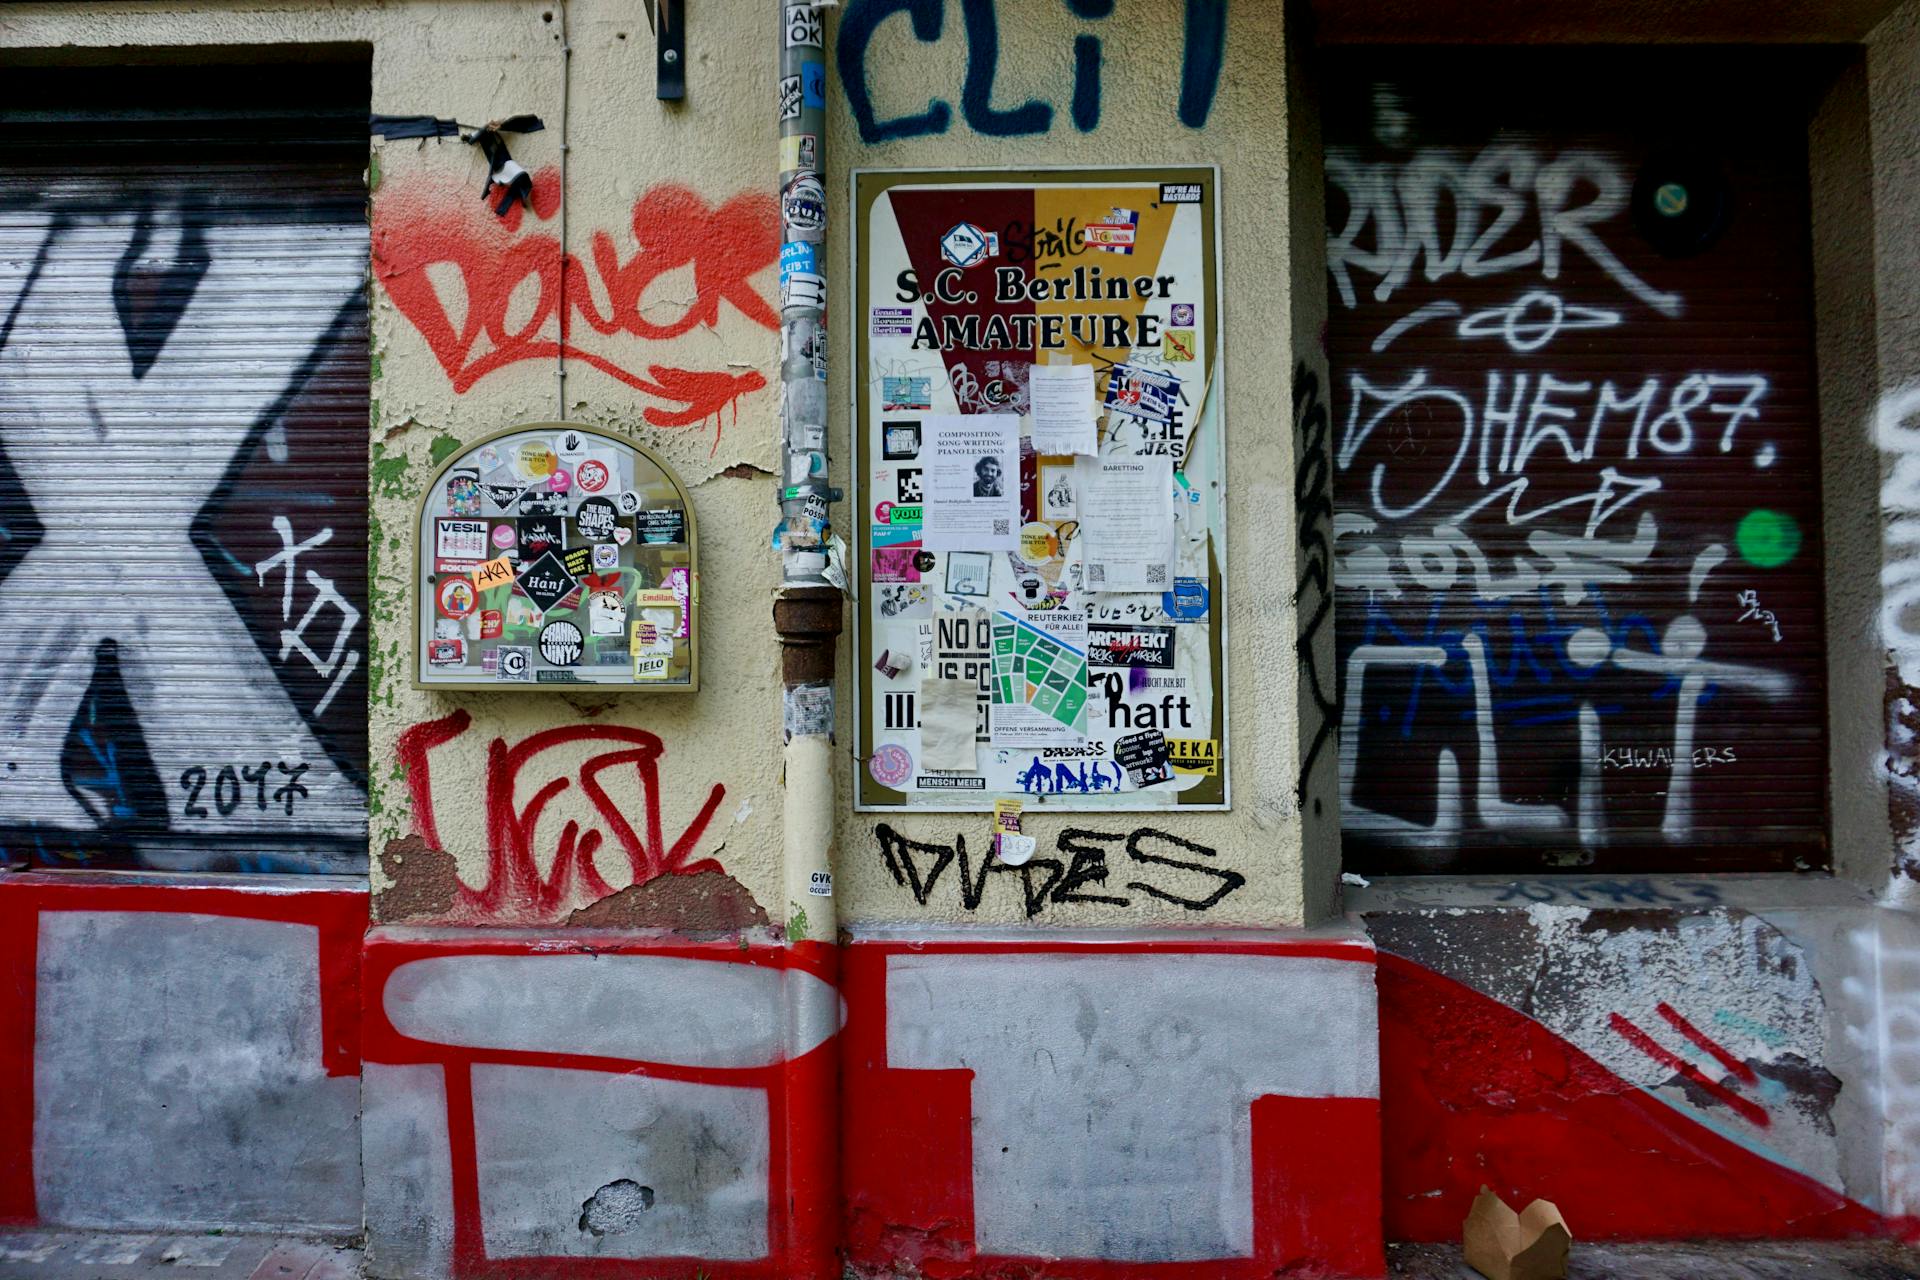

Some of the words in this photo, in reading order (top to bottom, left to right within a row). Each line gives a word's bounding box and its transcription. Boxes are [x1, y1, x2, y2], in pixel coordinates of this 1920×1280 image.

[791, 26, 820, 45] OK
[1162, 193, 1201, 201] BASTARDS
[1164, 185, 1187, 193] WE'RE
[1188, 185, 1201, 193] ALL
[896, 267, 977, 303] S.C.
[995, 266, 1175, 303] Berliner
[911, 314, 1162, 351] AMATEURE
[586, 503, 598, 513] THE
[598, 504, 611, 514] BAD
[440, 522, 487, 533] VESIL
[579, 511, 615, 531] SHAPES
[477, 561, 510, 585] AKA
[528, 576, 565, 593] Hanf
[541, 621, 581, 643] FRANKS
[938, 618, 970, 649] NO
[1088, 631, 1169, 649] ARCHITEKT
[1108, 695, 1192, 729] haft
[1125, 757, 1153, 768] artwork?
[919, 778, 956, 788] MENSCH
[957, 778, 984, 788] MEIER
[811, 872, 832, 884] GVK
